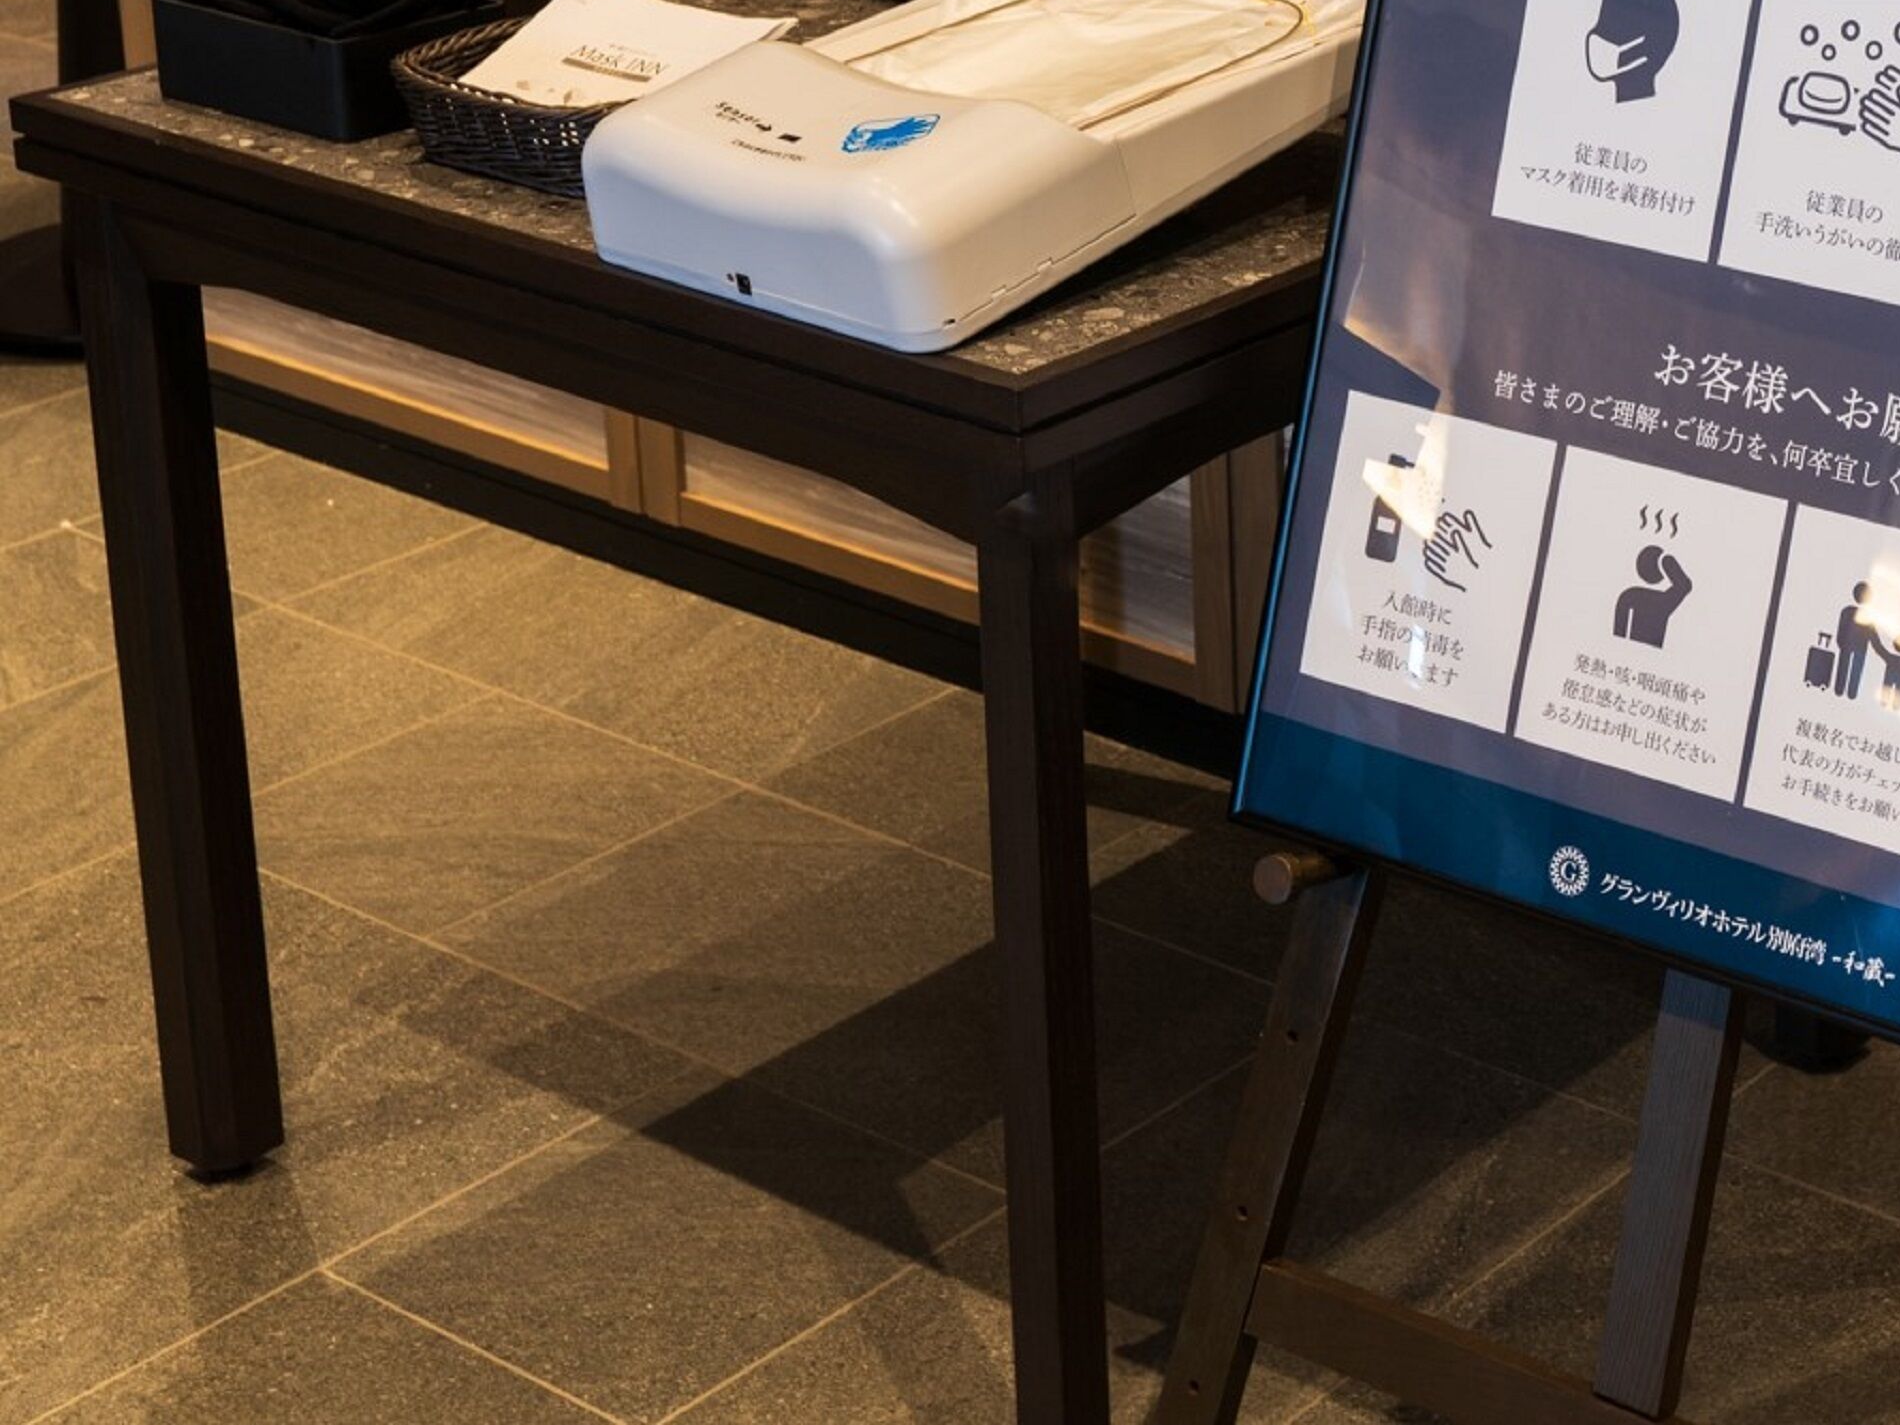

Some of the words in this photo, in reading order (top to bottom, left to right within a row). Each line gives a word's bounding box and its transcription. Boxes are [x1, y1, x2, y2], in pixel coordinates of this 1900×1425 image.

[1573, 141, 1649, 175] 従業員の
[1520, 164, 1696, 217] マスク着用を義務付け
[1805, 188, 1885, 223] 従業員の
[1382, 590, 1452, 626] 入館時に
[1356, 643, 1460, 687] お願います
[1541, 701, 1716, 764] ある方はお申し出ください
[1599, 872, 1828, 967] グランヴィリオホテル別府湾
